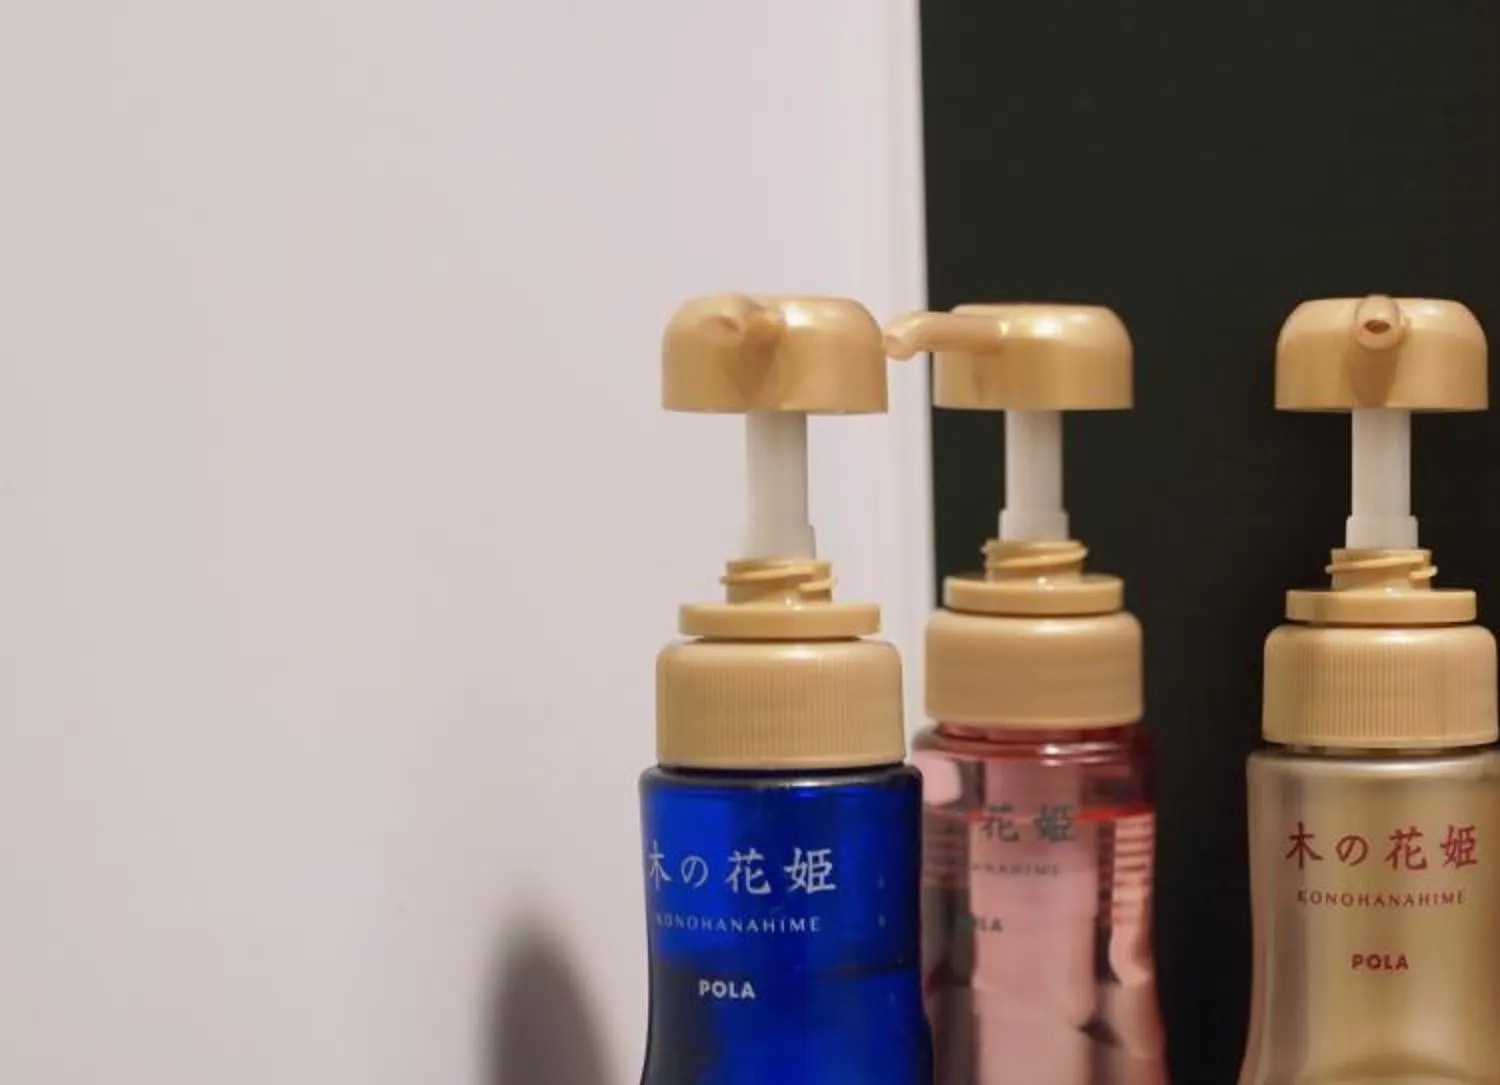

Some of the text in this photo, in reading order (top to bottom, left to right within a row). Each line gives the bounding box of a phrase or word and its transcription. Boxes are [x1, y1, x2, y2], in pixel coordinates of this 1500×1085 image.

[1285, 821, 1478, 871] 木の花姫
[648, 839, 836, 894] 木の花姫
[1297, 889, 1464, 908] KONOHANAHIME
[656, 912, 822, 933] KONOHANAHIME
[1351, 953, 1410, 971] POLA
[699, 979, 756, 999] POLA
